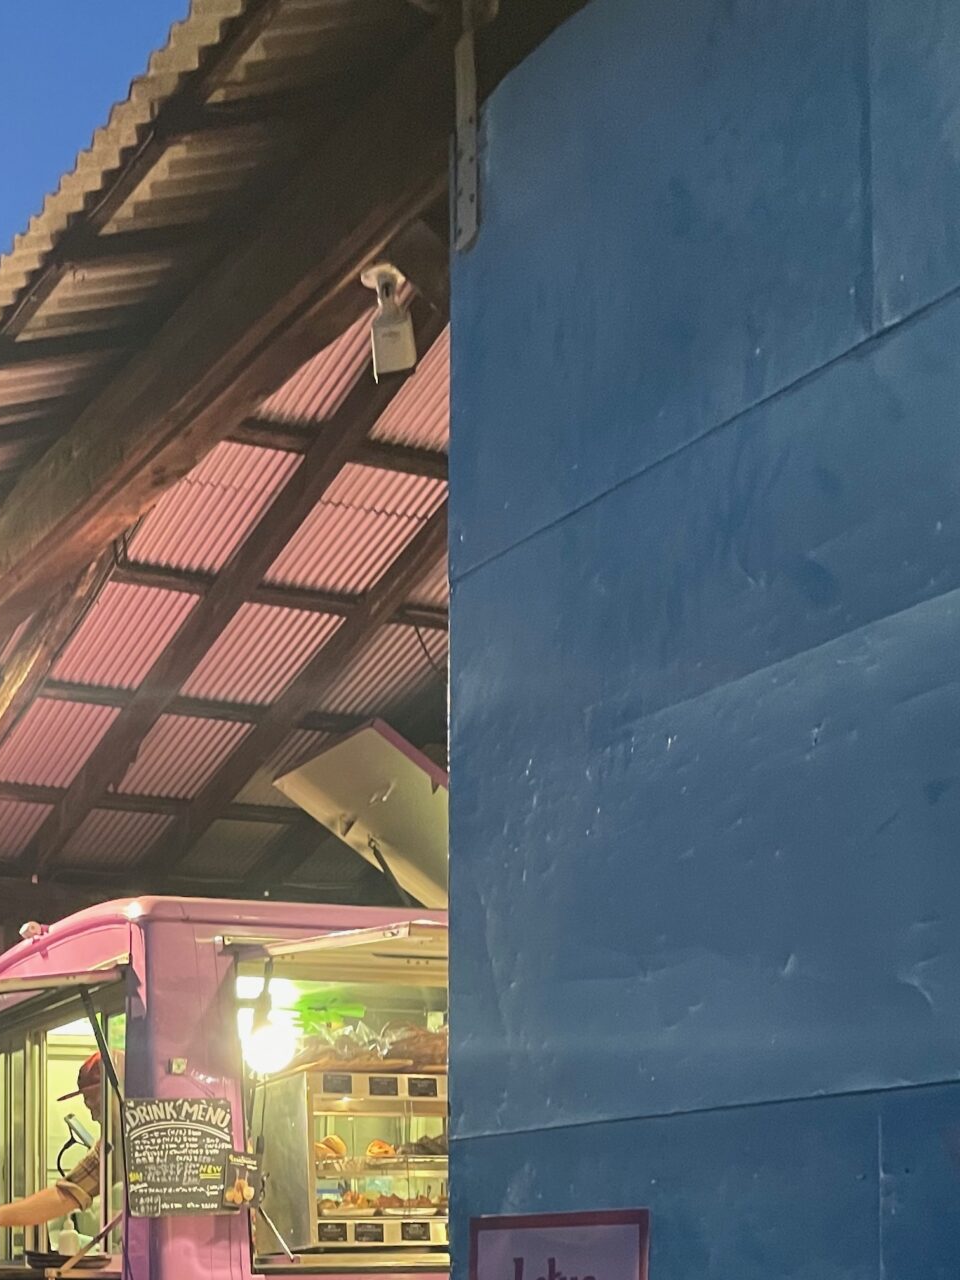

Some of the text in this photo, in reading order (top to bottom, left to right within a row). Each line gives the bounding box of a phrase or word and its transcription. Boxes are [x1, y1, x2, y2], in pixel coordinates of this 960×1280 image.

[126, 1100, 231, 1128] DRINK MENU
[200, 1165, 222, 1174] NEW
